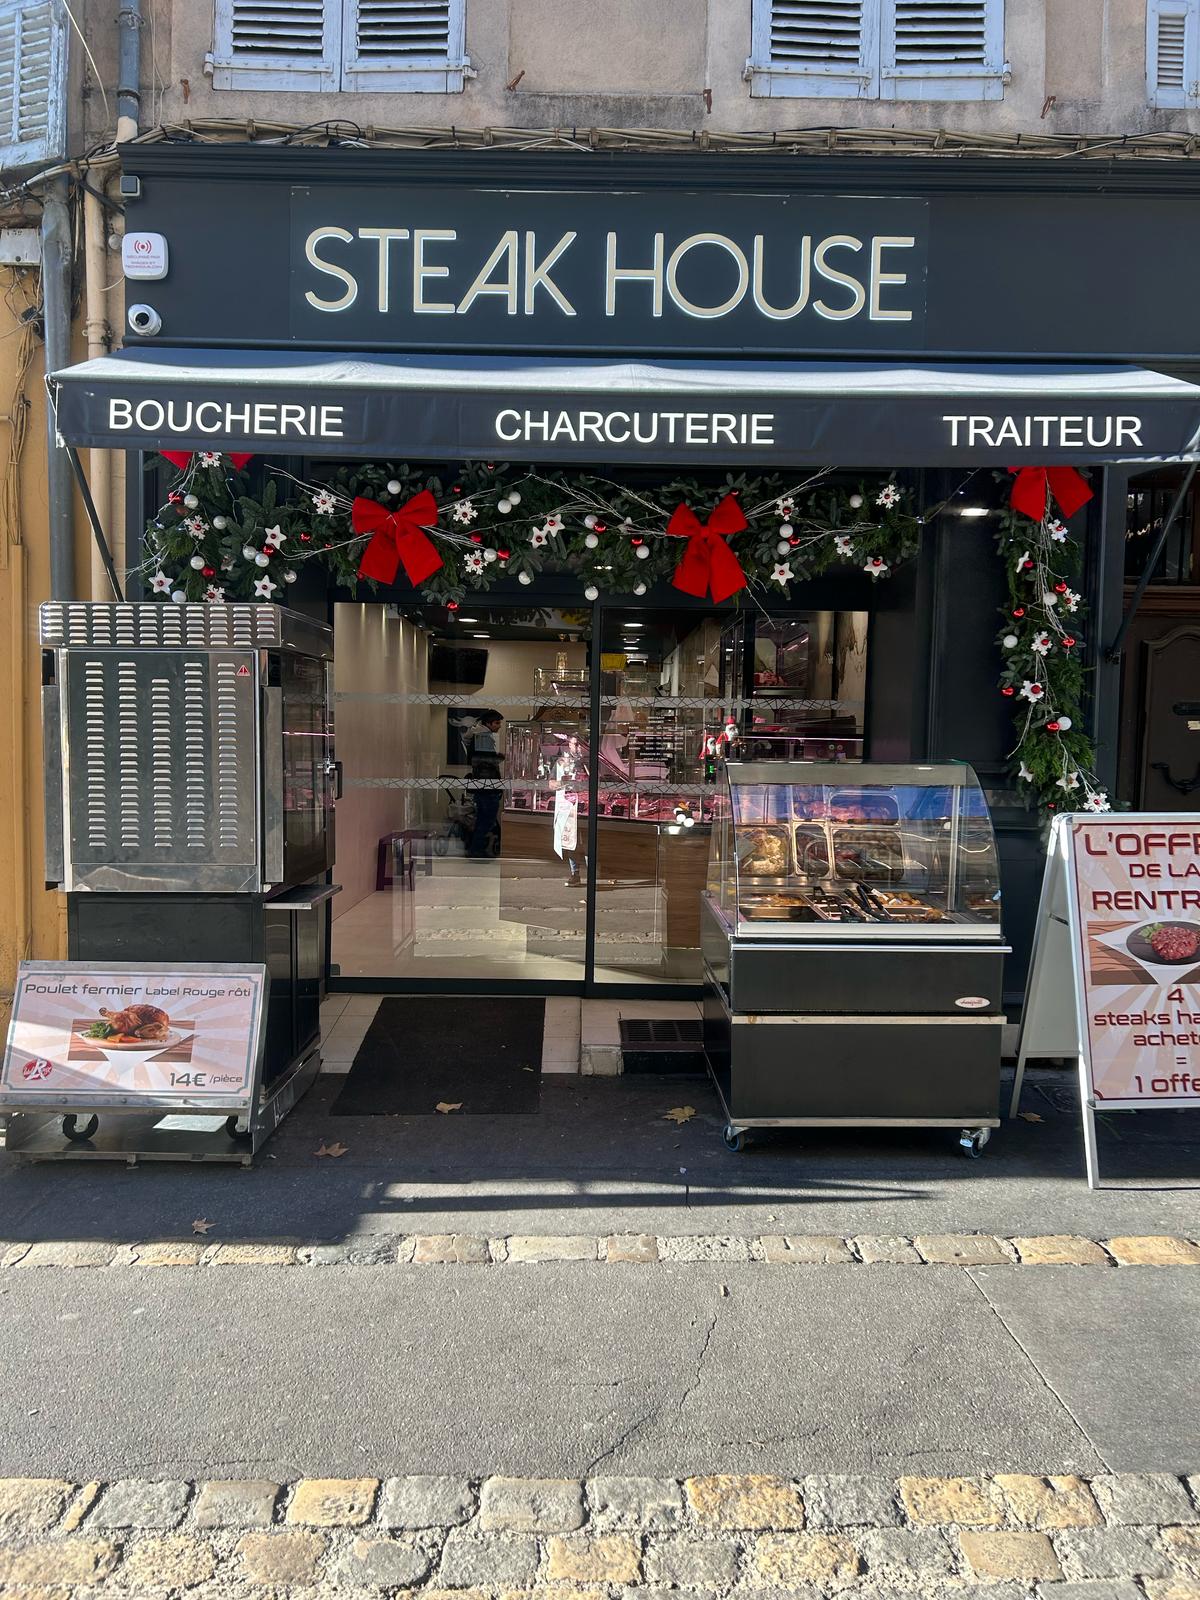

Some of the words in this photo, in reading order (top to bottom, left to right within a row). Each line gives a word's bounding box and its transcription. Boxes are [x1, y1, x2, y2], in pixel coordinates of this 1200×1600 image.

[305, 227, 577, 315] STEAK
[606, 232, 914, 320] HOUSE
[109, 399, 343, 442] BOUCHERIE
[496, 410, 774, 444] CHARCUTERIE
[943, 416, 1143, 446] TRAITEUR
[1129, 864, 1161, 877] DE
[1168, 864, 1200, 877] LA
[25, 983, 78, 994] Poulet
[82, 983, 142, 995] fermier
[145, 986, 180, 996] Label
[182, 987, 225, 999] Rouge
[228, 987, 251, 997] rôti
[1167, 988, 1185, 1004] 4
[1094, 1010, 1171, 1026] steaks
[170, 1072, 207, 1087] 14€
[1134, 1075, 1144, 1093] 1
